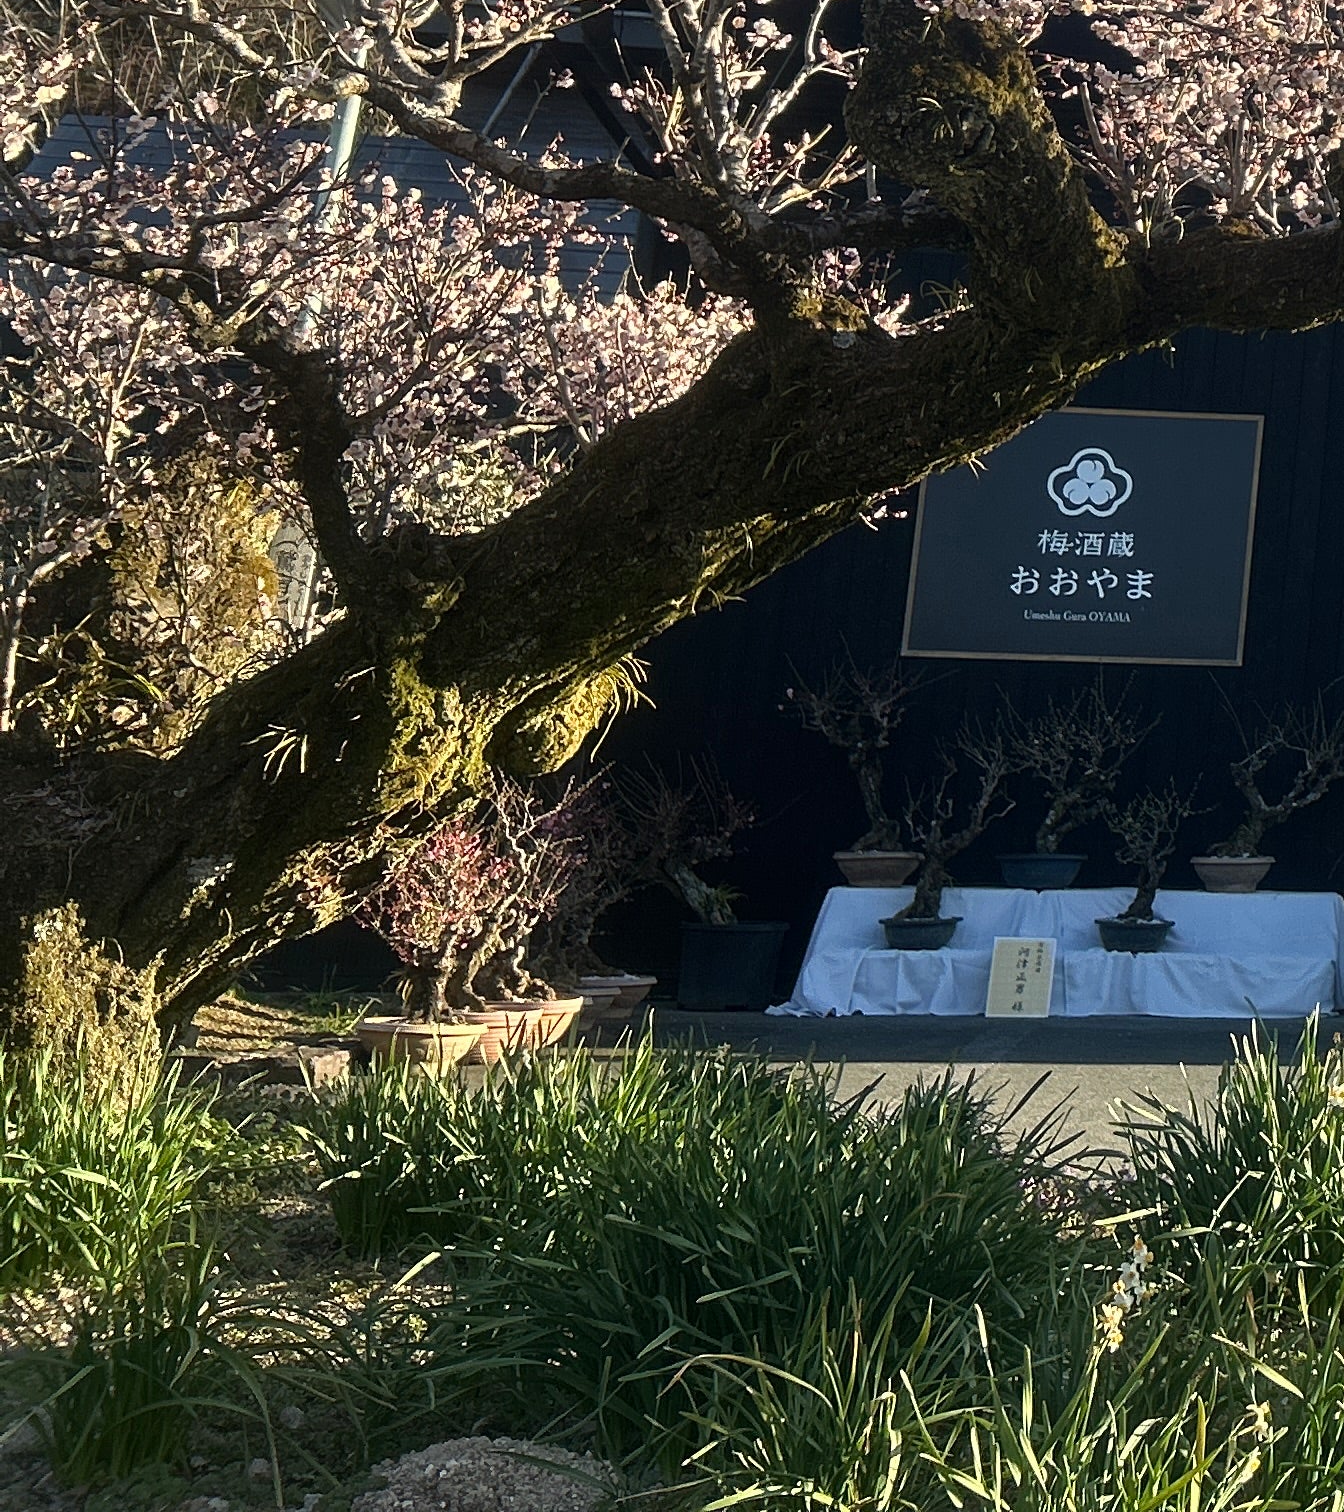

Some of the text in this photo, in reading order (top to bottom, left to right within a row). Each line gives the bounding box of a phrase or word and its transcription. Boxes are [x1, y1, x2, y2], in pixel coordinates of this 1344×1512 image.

[1037, 529, 1135, 558] 梅酒蔵
[1010, 565, 1154, 599] おおやま
[1023, 609, 1131, 623] Umeshu Gura OYAMA
